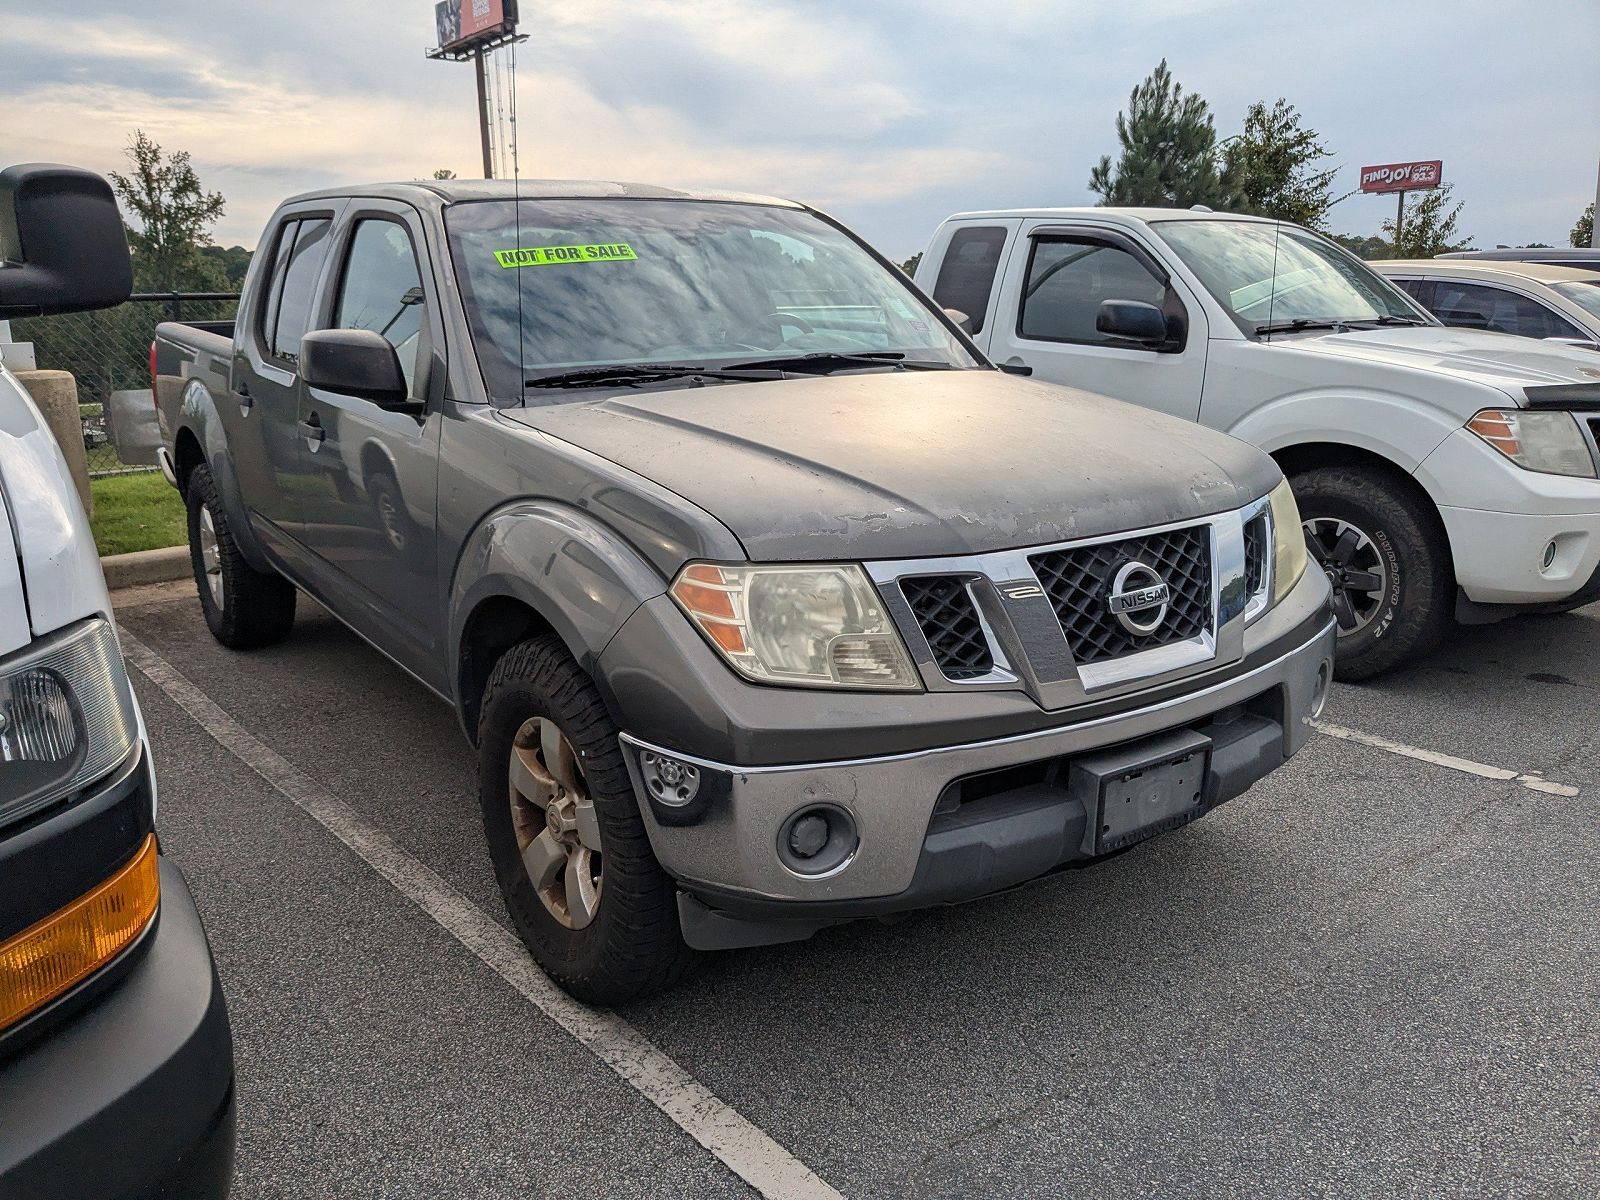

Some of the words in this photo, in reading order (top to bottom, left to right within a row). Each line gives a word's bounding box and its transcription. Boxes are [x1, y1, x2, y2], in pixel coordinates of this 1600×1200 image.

[1412, 172, 1436, 182] 93.3
[500, 250, 537, 264] NOT
[543, 247, 582, 261] FOR
[585, 245, 630, 258] SALE
[1121, 585, 1168, 609] NISSAN
[1373, 607, 1393, 638] AT2
